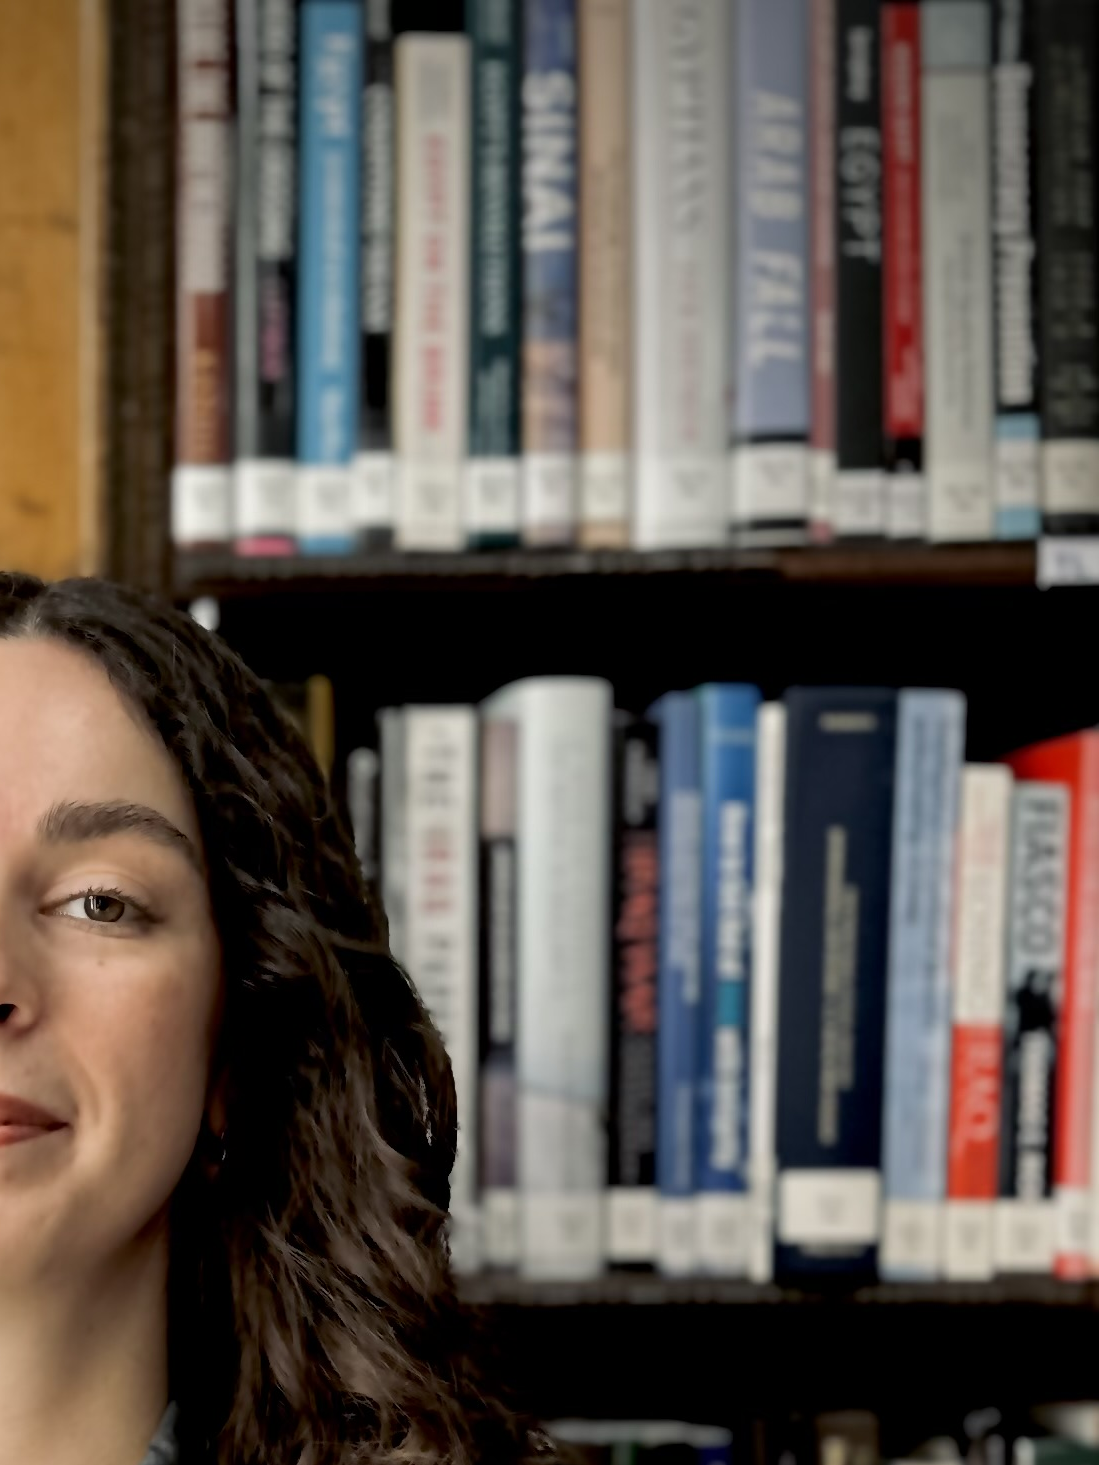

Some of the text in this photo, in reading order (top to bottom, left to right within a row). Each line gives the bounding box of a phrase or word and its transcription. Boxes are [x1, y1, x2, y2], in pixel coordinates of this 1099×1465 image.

[522, 70, 574, 251] SINAI
[748, 88, 801, 368] ARAB FALL
[839, 126, 881, 263] EGYPT
[1019, 797, 1058, 957] FIASCO
